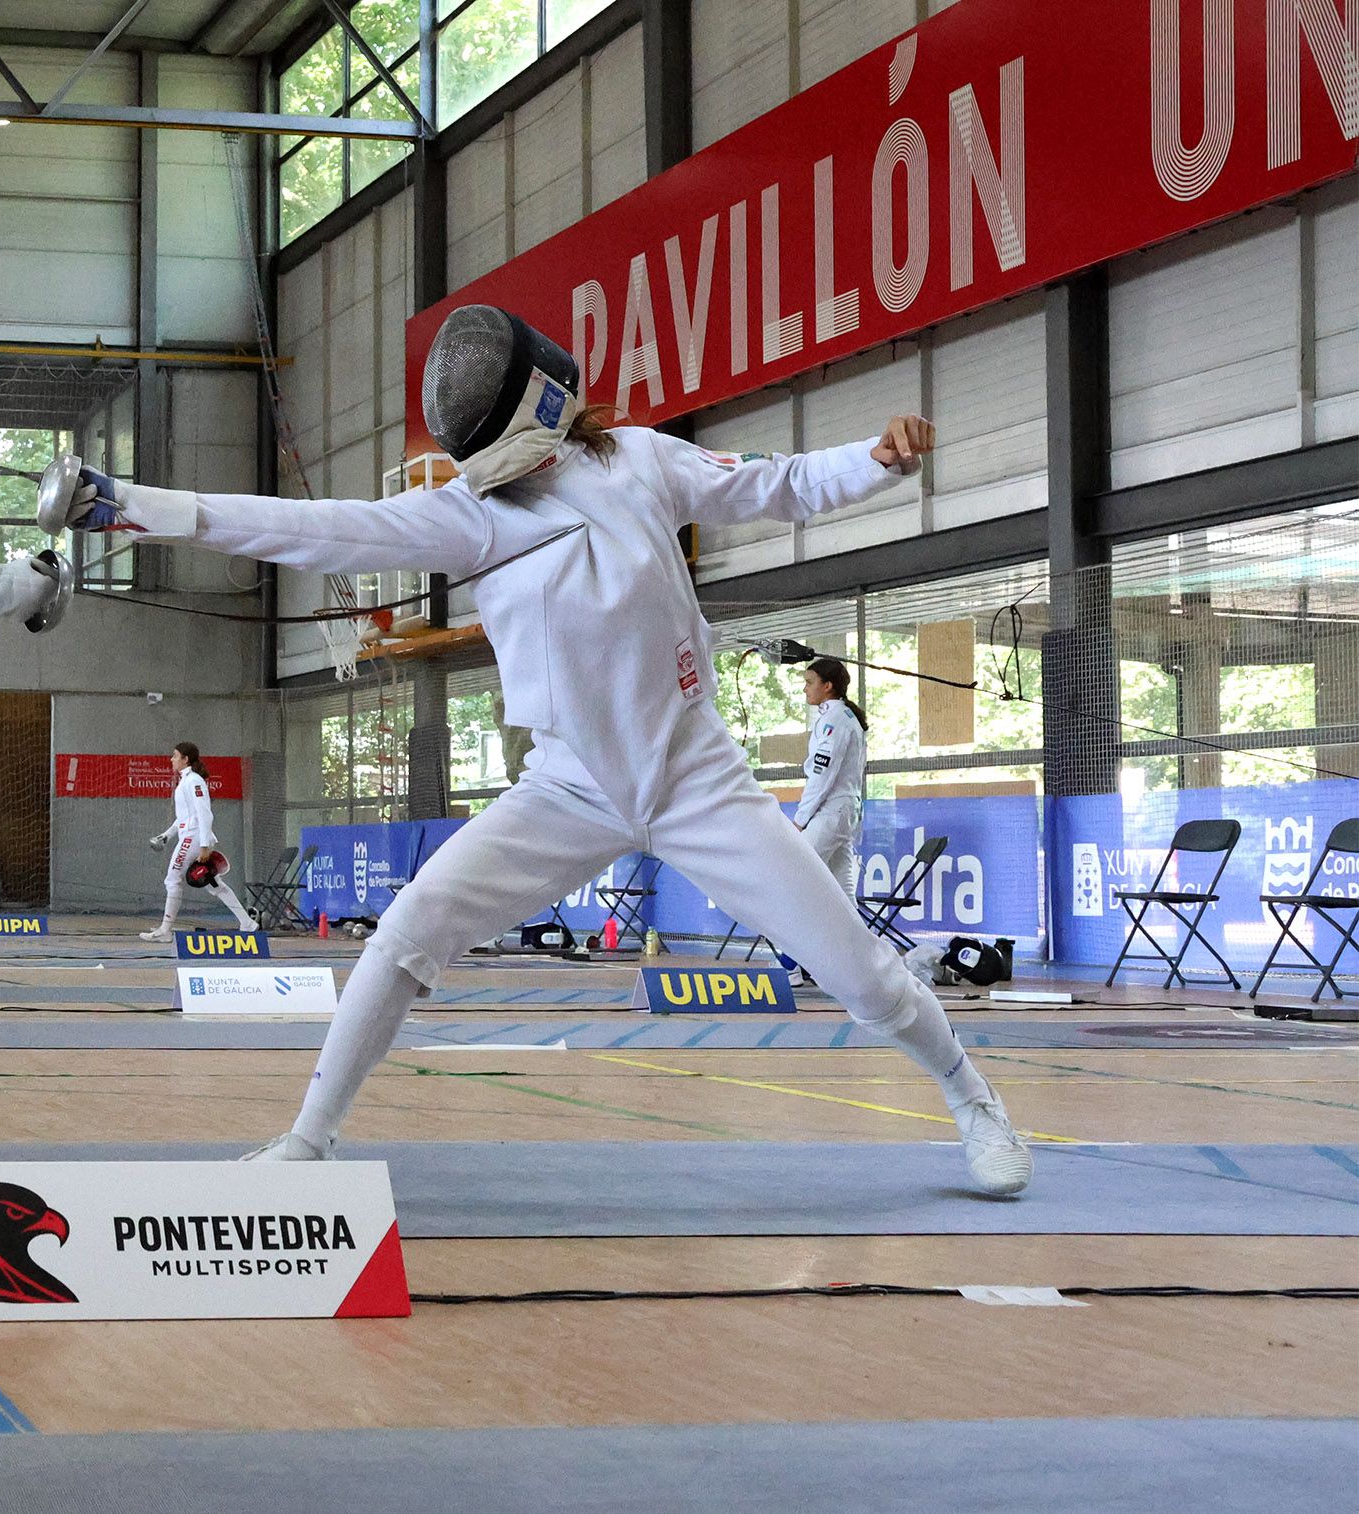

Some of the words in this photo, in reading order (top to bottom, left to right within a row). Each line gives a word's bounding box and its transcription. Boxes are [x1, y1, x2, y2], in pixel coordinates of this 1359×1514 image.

[572, 33, 1026, 421] PAVILLÓN
[186, 935, 259, 955] UIPM
[208, 986, 221, 994] DE
[223, 986, 263, 994] GALICIA
[660, 973, 778, 1005] UIPM
[113, 1215, 357, 1252] PONTEVEDRA
[152, 1258, 330, 1277] MULTISPORT
